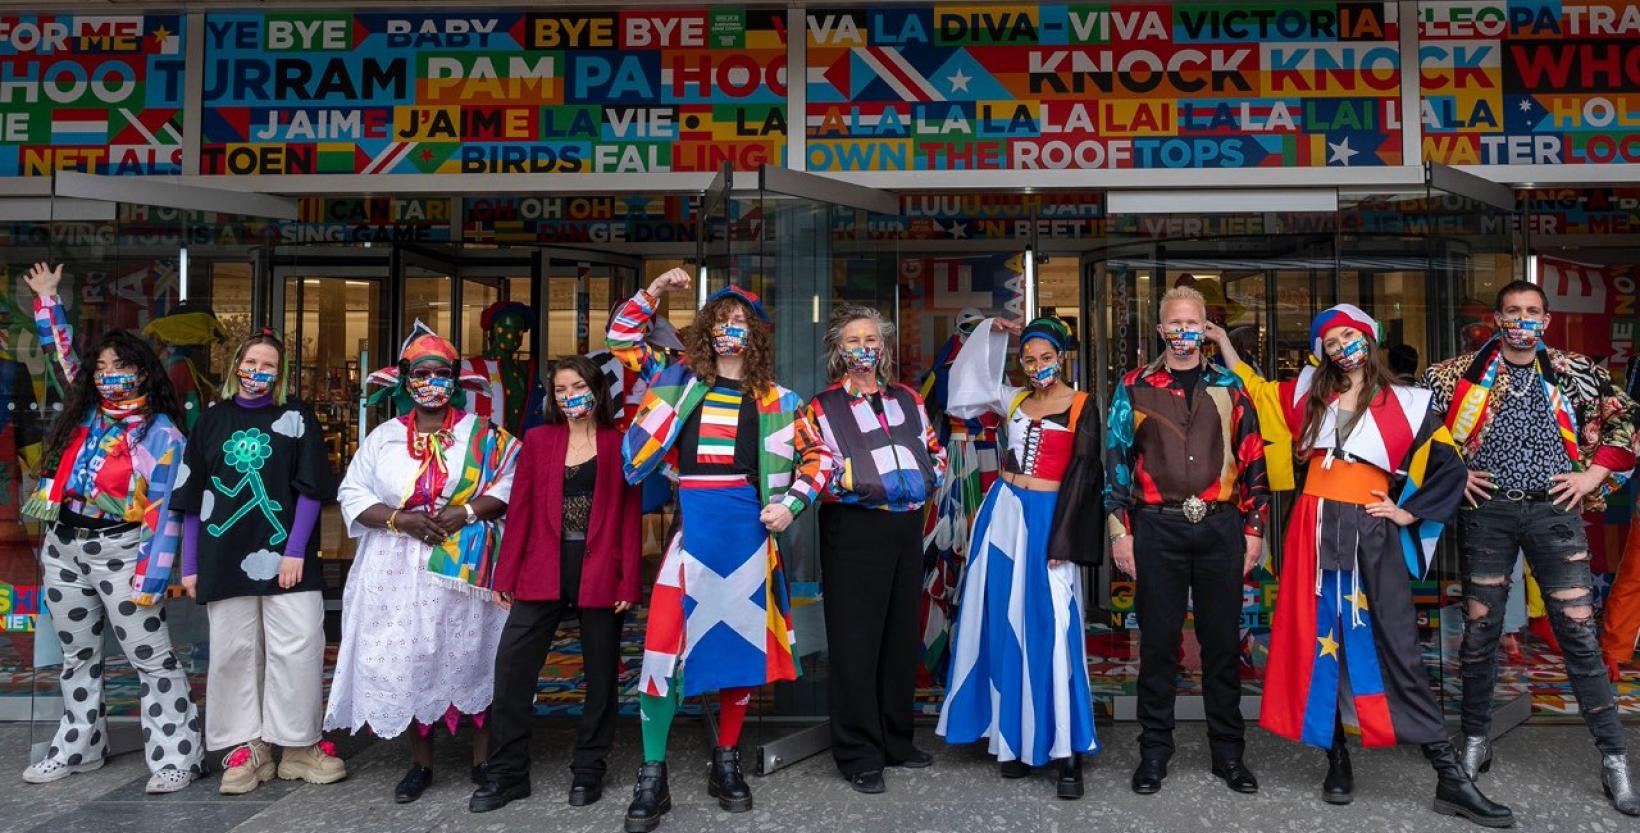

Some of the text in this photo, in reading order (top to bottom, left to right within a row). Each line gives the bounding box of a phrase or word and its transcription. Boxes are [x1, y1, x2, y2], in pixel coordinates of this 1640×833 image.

[80, 22, 138, 51] ME
[208, 21, 259, 49] YE
[268, 20, 347, 50] BYE
[387, 19, 498, 48] BABY
[535, 18, 614, 47] BYE
[626, 17, 704, 47] BYE
[874, 13, 929, 43] LA
[1180, 8, 1383, 39] VICTORIA
[427, 56, 555, 100] PAM
[574, 55, 655, 99] PA
[1029, 49, 1253, 94] KNOCK
[256, 109, 388, 139] J'AIME
[398, 109, 530, 138] J'AIME
[545, 109, 598, 138] LA
[605, 108, 673, 138] VIE
[916, 104, 972, 134] LA
[1105, 103, 1170, 132] LAI
[1305, 100, 1373, 131] LAI
[462, 145, 582, 174] BIRDS
[920, 141, 1006, 170] THE
[520, 198, 561, 219] OH
[569, 198, 612, 219] OH
[1144, 215, 1284, 239] VERLIEF
